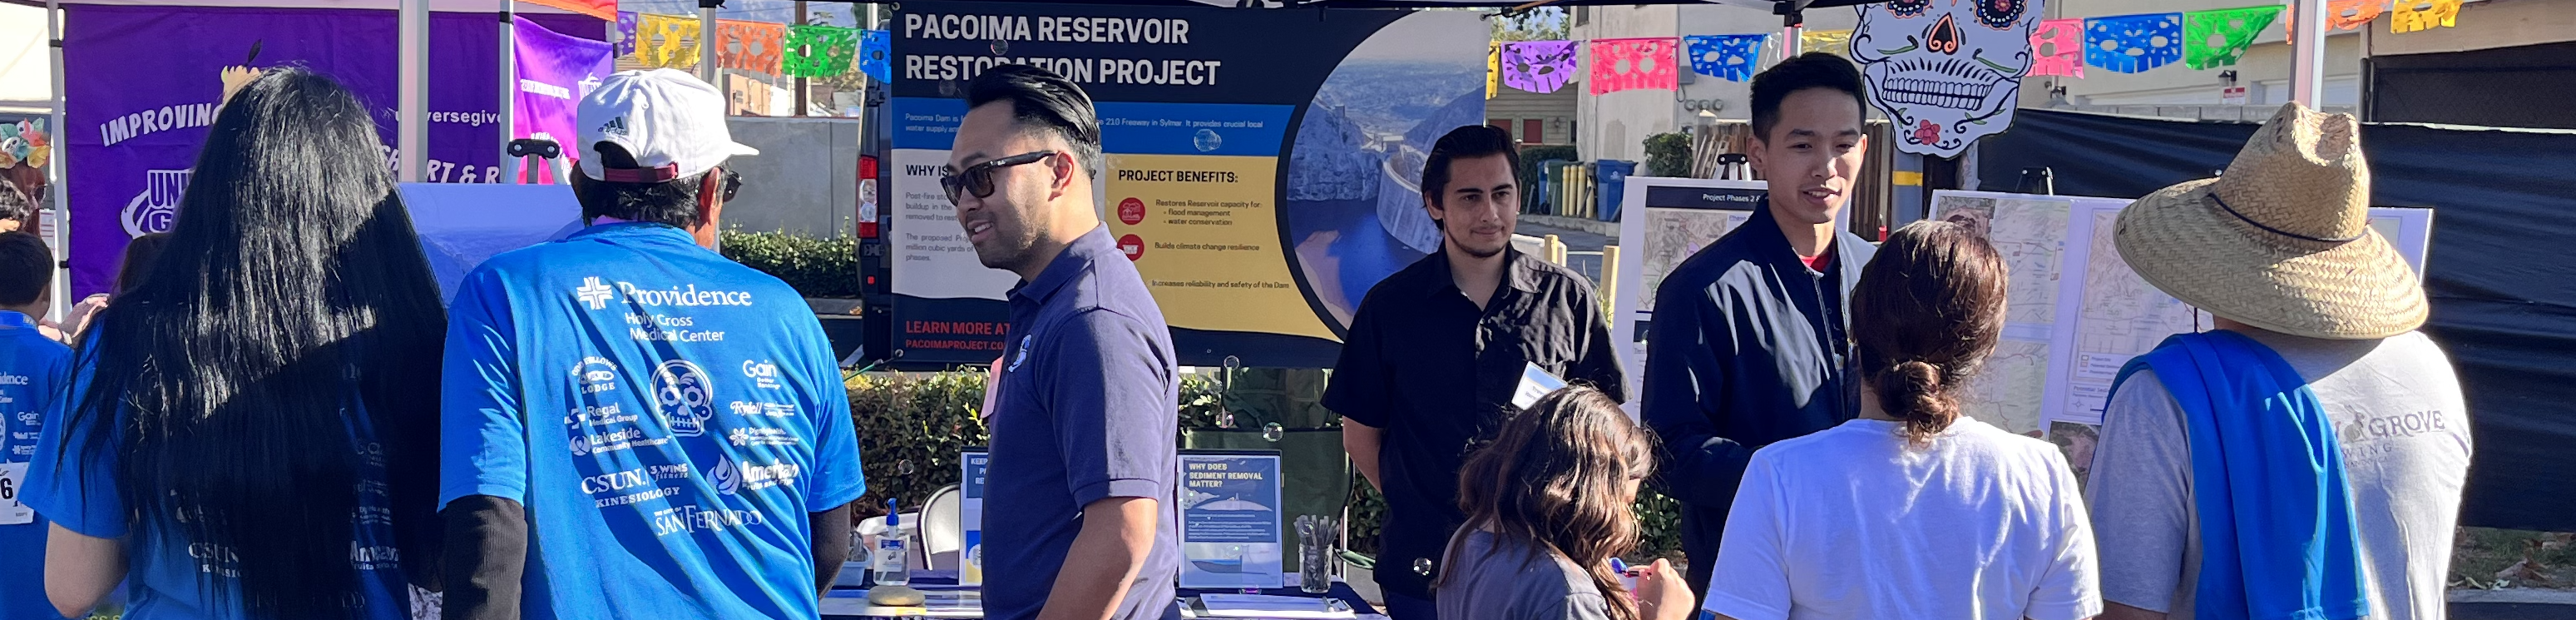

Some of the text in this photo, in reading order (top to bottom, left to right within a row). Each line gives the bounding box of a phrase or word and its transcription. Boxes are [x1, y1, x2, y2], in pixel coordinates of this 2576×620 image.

[905, 13, 1189, 43] PACOIMA RESERVOIR
[1100, 58, 1221, 86] PROJECT
[935, 114, 951, 122] Dam
[1105, 117, 1120, 126] 210
[1121, 118, 1150, 127] Freeway
[1193, 120, 1221, 128] provides
[926, 125, 947, 133] supply
[906, 165, 936, 176] WHY
[1118, 170, 1239, 183] PROJECT BENEFITS:
[905, 191, 935, 200] Post-fire
[905, 202, 929, 211] buildup
[1155, 199, 1186, 207] Restores
[1220, 201, 1248, 209] capacity
[1187, 210, 1230, 218] management
[1202, 243, 1226, 251] change
[1185, 280, 1215, 288] reliability
[1230, 280, 1252, 289] safety
[617, 281, 753, 306] Providence
[625, 311, 693, 328] Holy Cross
[906, 320, 950, 334] LEARN
[952, 321, 991, 335] MORE
[630, 328, 725, 342] Medical Center
[905, 339, 1006, 350] PACOIMAPROJECT.CO
[742, 359, 777, 378] Gain
[581, 381, 616, 394] LODGE
[586, 402, 621, 418] Regal
[616, 414, 638, 424] Group
[2369, 410, 2445, 439] GROVE
[590, 427, 641, 446] Lakeside
[650, 465, 657, 474] 3
[659, 463, 688, 474] WINS
[1227, 472, 1263, 480] REMOVAL
[596, 486, 680, 508] KINESIOLOGY
[655, 512, 686, 537] SAN
